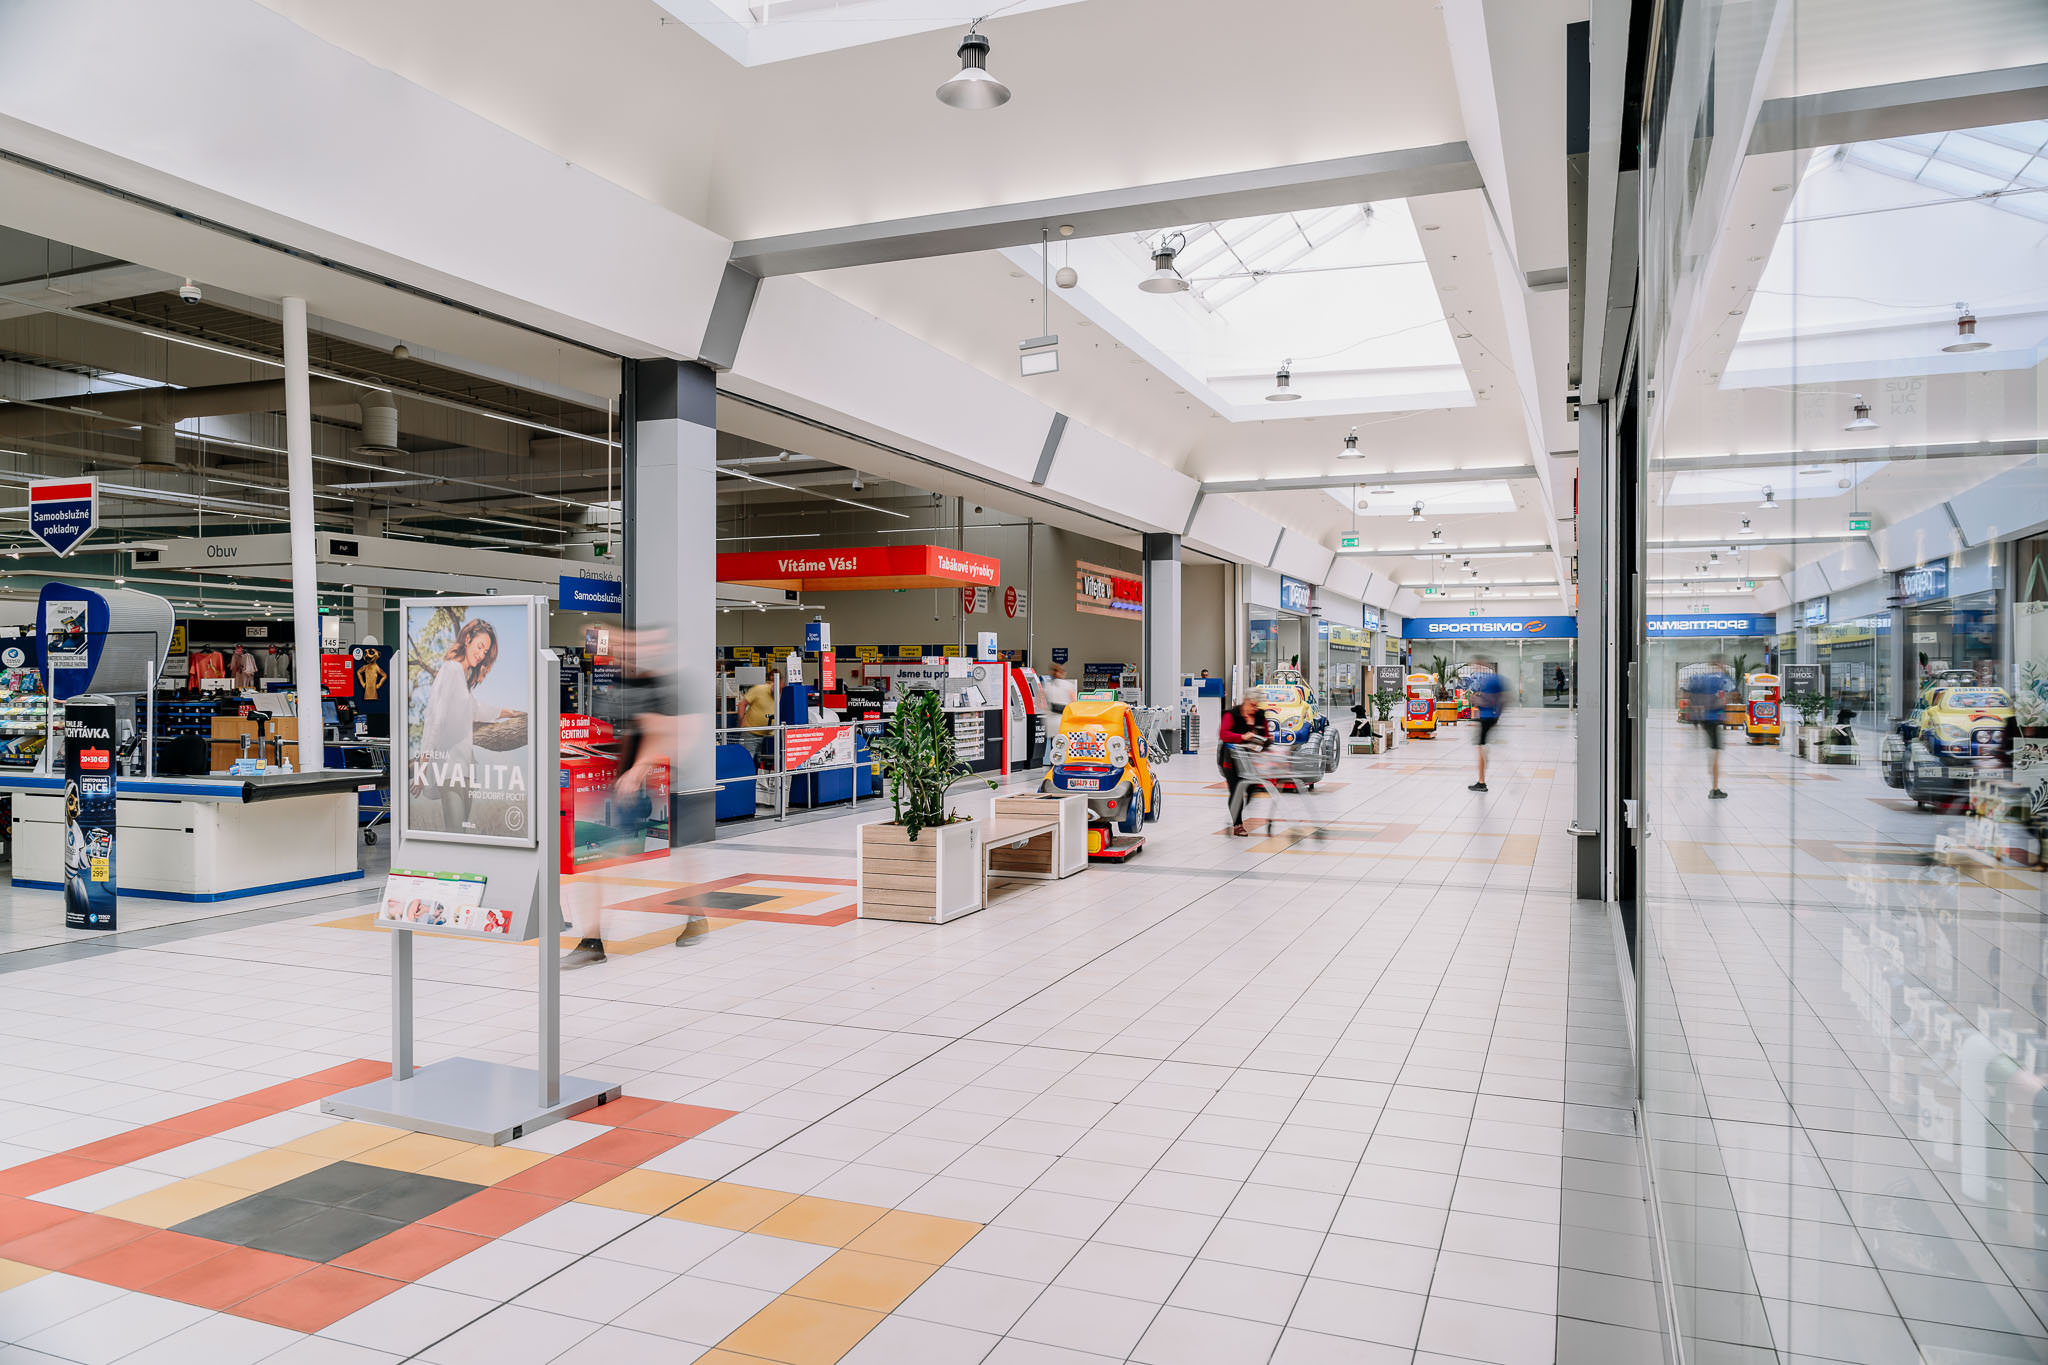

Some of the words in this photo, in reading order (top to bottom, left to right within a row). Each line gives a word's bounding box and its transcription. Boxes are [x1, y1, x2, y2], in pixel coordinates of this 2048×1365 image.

[34, 508, 89, 522] Samoobslužné
[43, 523, 79, 537] pokladny
[206, 545, 238, 558] Obuv
[778, 558, 826, 573] Vítáme
[828, 556, 857, 571] Vás!
[937, 555, 969, 574] Tabákové
[969, 560, 995, 581] výrobky
[580, 568, 613, 581] Dámské
[574, 589, 622, 604] Samoobslužné
[247, 627, 267, 636] F&F
[1428, 622, 1523, 633] SPORTISIMO
[897, 669, 921, 679] Jsme
[923, 670, 932, 678] tu
[934, 671, 950, 680] pro
[571, 719, 576, 727] s
[561, 729, 590, 740] CENTRUM
[1070, 742, 1104, 751] CITY
[81, 755, 97, 763] 20+30
[413, 761, 526, 791] KVALITA
[82, 783, 108, 792] EDICE
[468, 791, 482, 799] PRO
